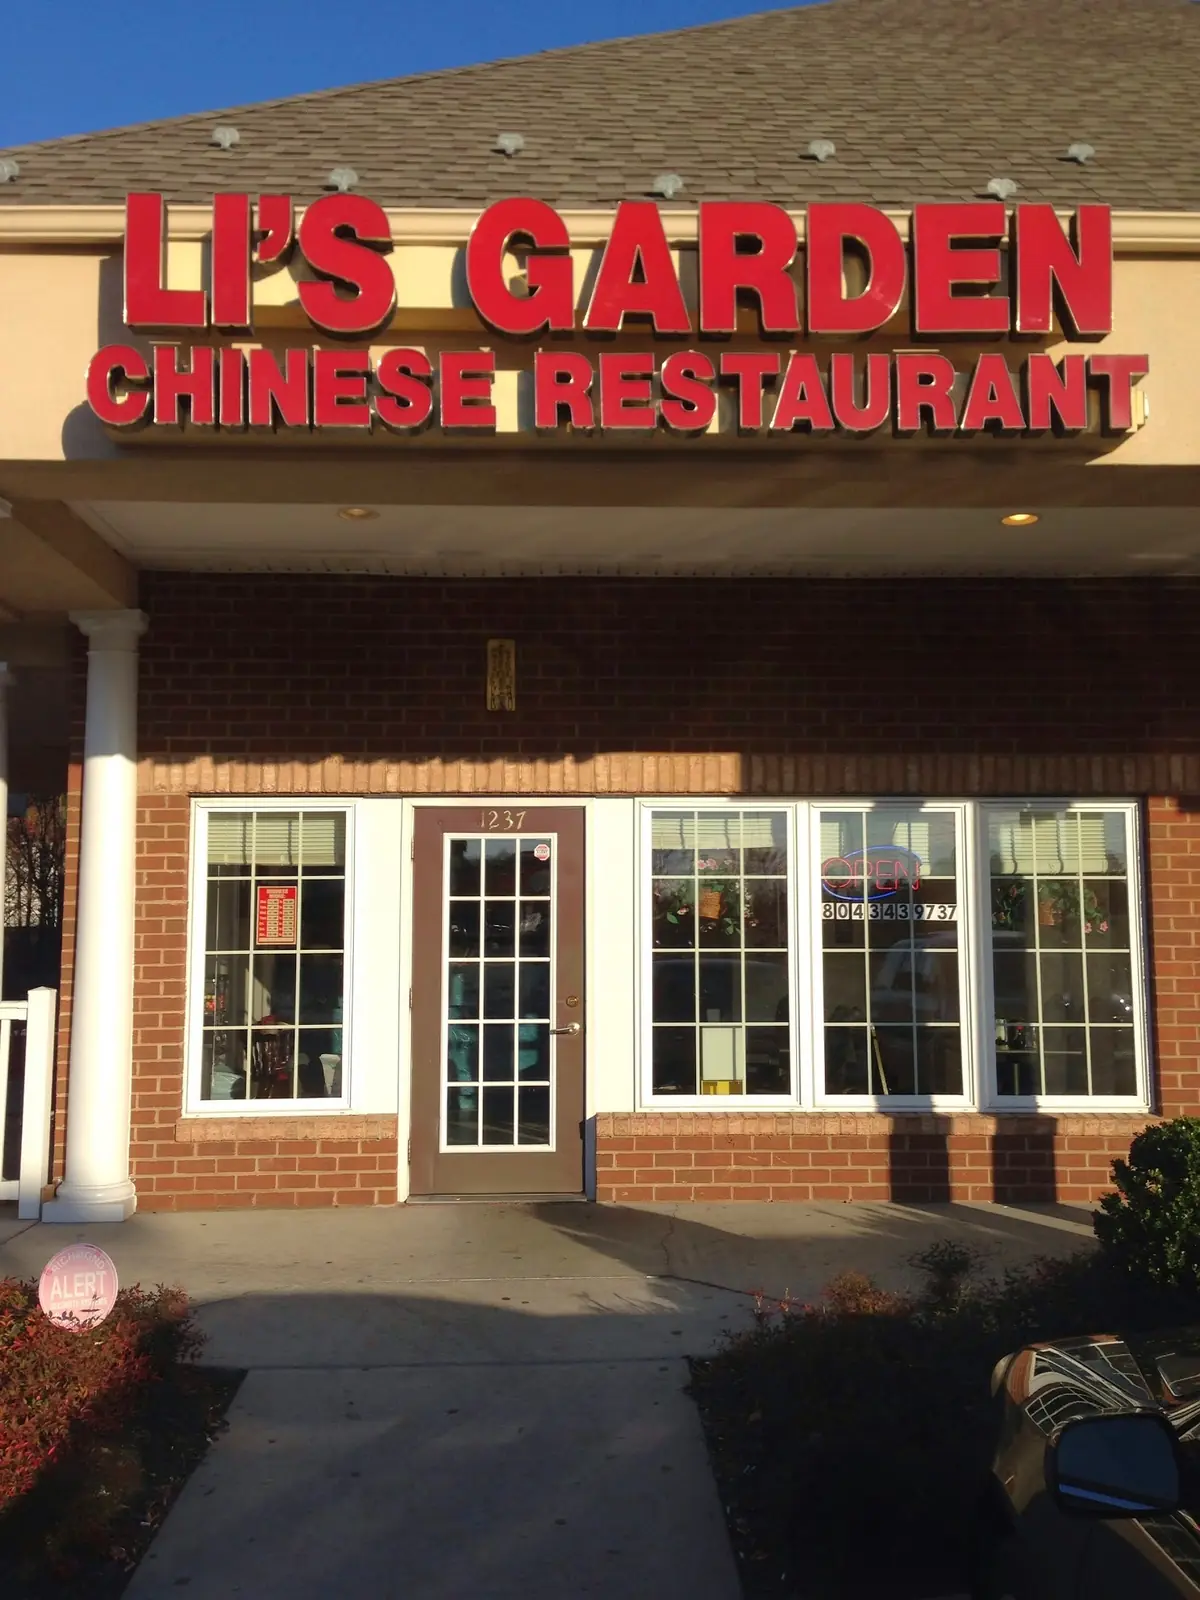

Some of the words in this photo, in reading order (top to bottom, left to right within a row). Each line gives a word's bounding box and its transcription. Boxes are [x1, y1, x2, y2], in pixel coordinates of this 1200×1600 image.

[122, 192, 398, 334] LI'S
[465, 197, 1113, 335] GARDEN
[86, 344, 497, 430] CHINESE
[533, 350, 1149, 433] RESTAURANT
[480, 810, 527, 830] 1237
[822, 857, 921, 890] OPEN
[822, 903, 957, 920] 8043439737
[50, 1270, 108, 1301] ALERT
